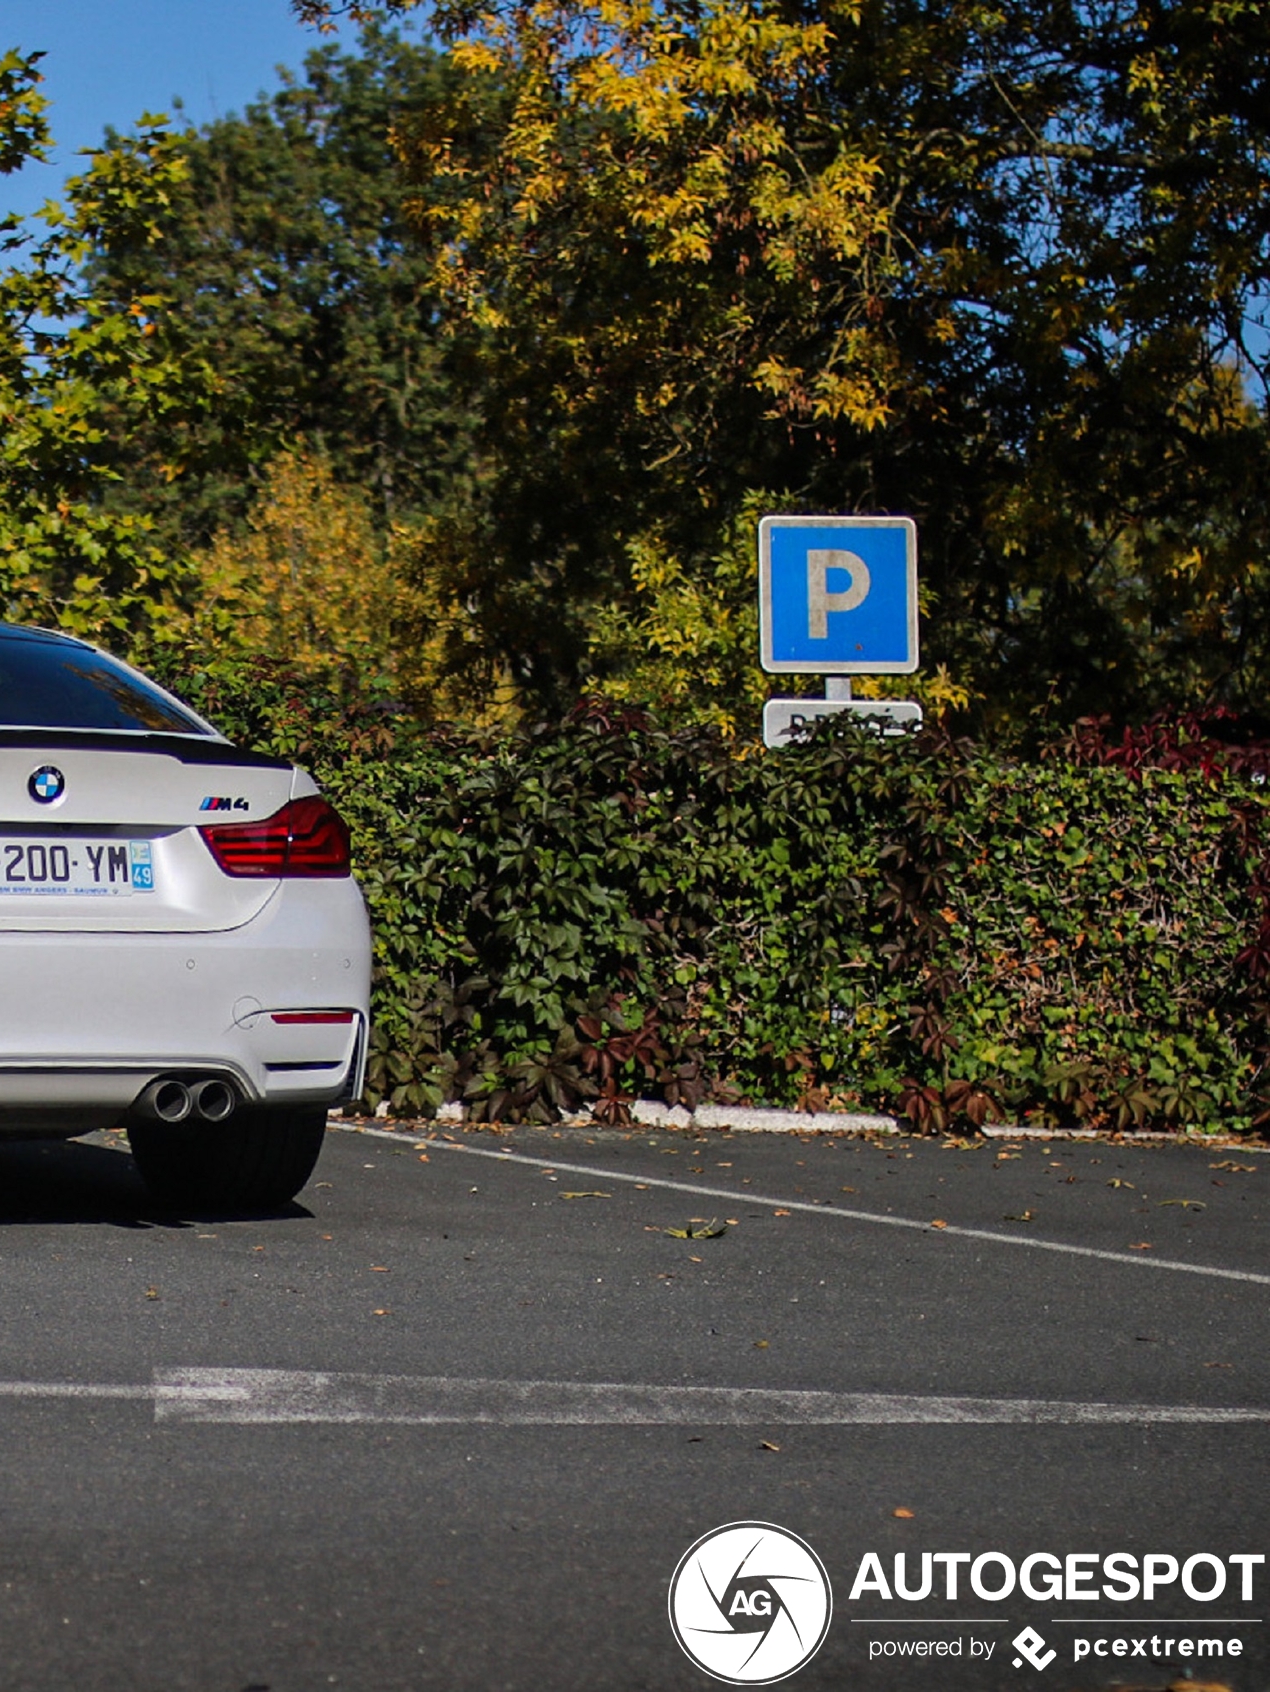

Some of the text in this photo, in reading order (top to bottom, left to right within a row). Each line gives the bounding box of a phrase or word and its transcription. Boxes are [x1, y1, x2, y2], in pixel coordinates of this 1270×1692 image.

[807, 549, 871, 639] P
[214, 797, 249, 811] M4
[133, 867, 151, 884] 49
